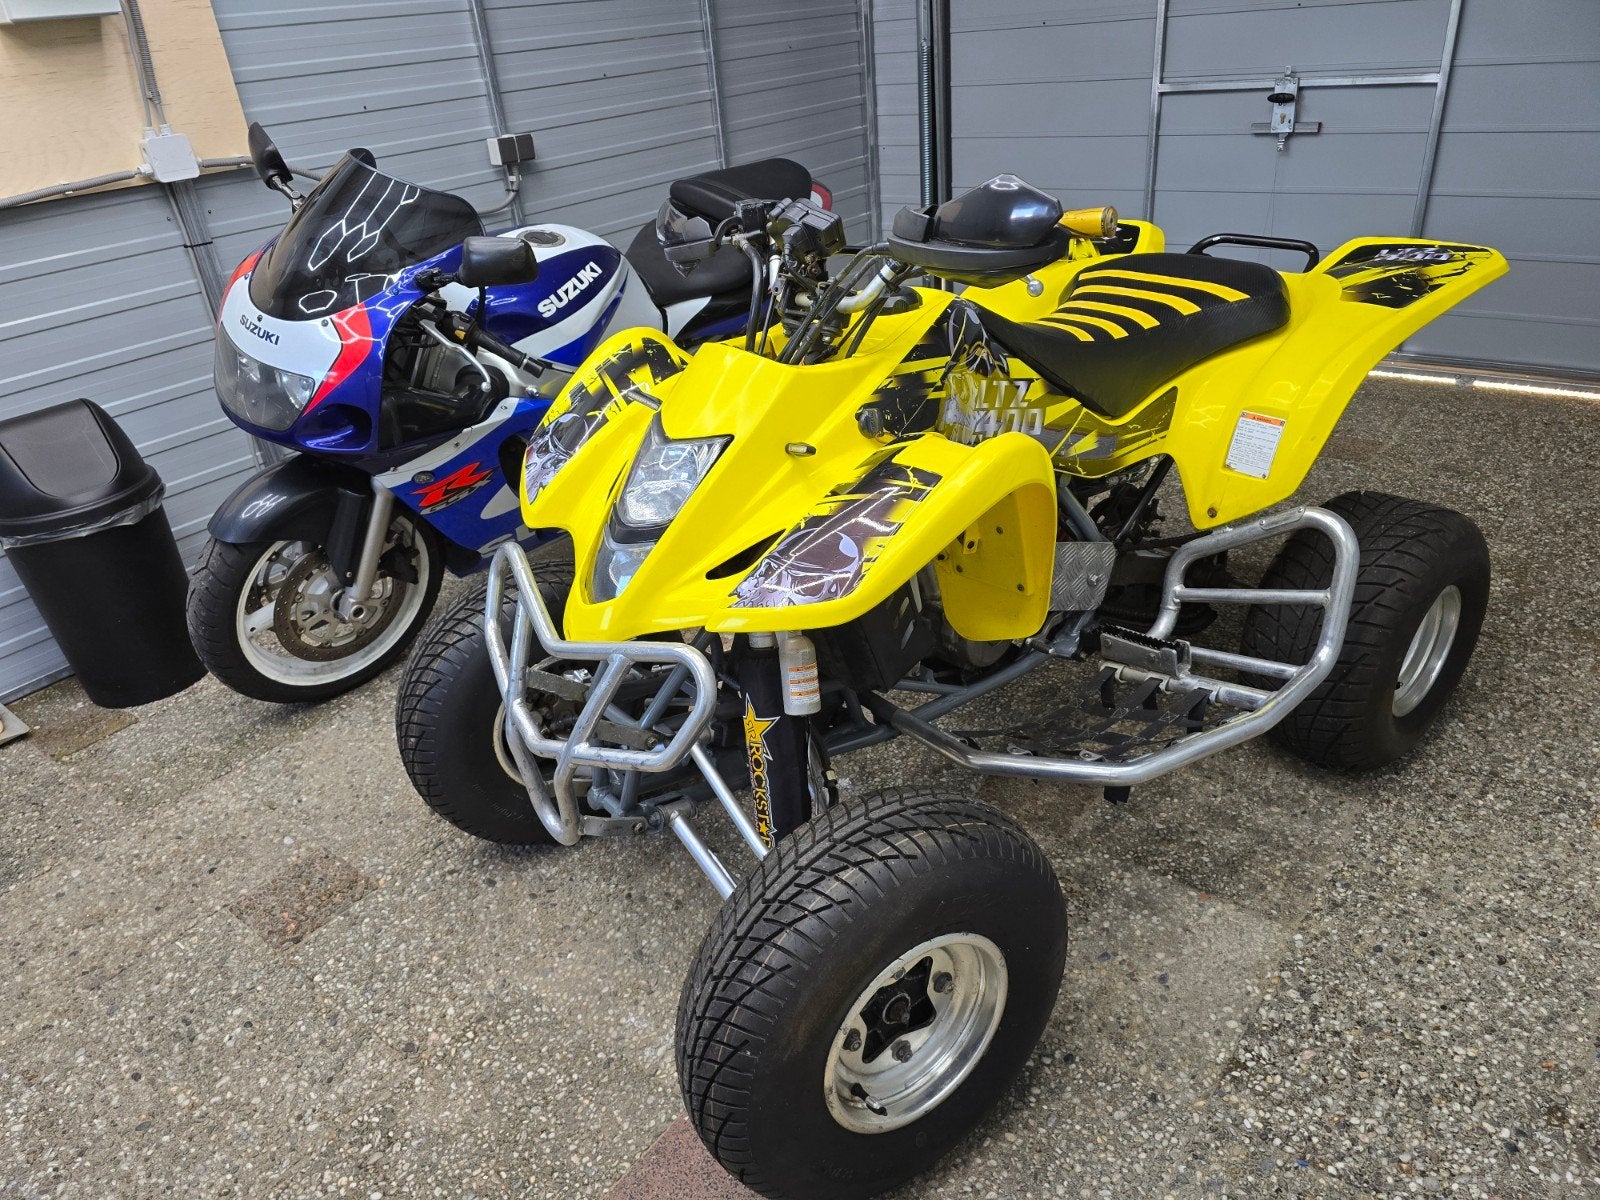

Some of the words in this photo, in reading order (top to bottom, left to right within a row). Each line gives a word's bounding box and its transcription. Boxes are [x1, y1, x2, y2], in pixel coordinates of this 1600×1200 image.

[537, 261, 603, 318] SUZUKI
[240, 314, 280, 345] SUZUKI
[975, 380, 1032, 408] LTZ
[974, 408, 1043, 440] 400
